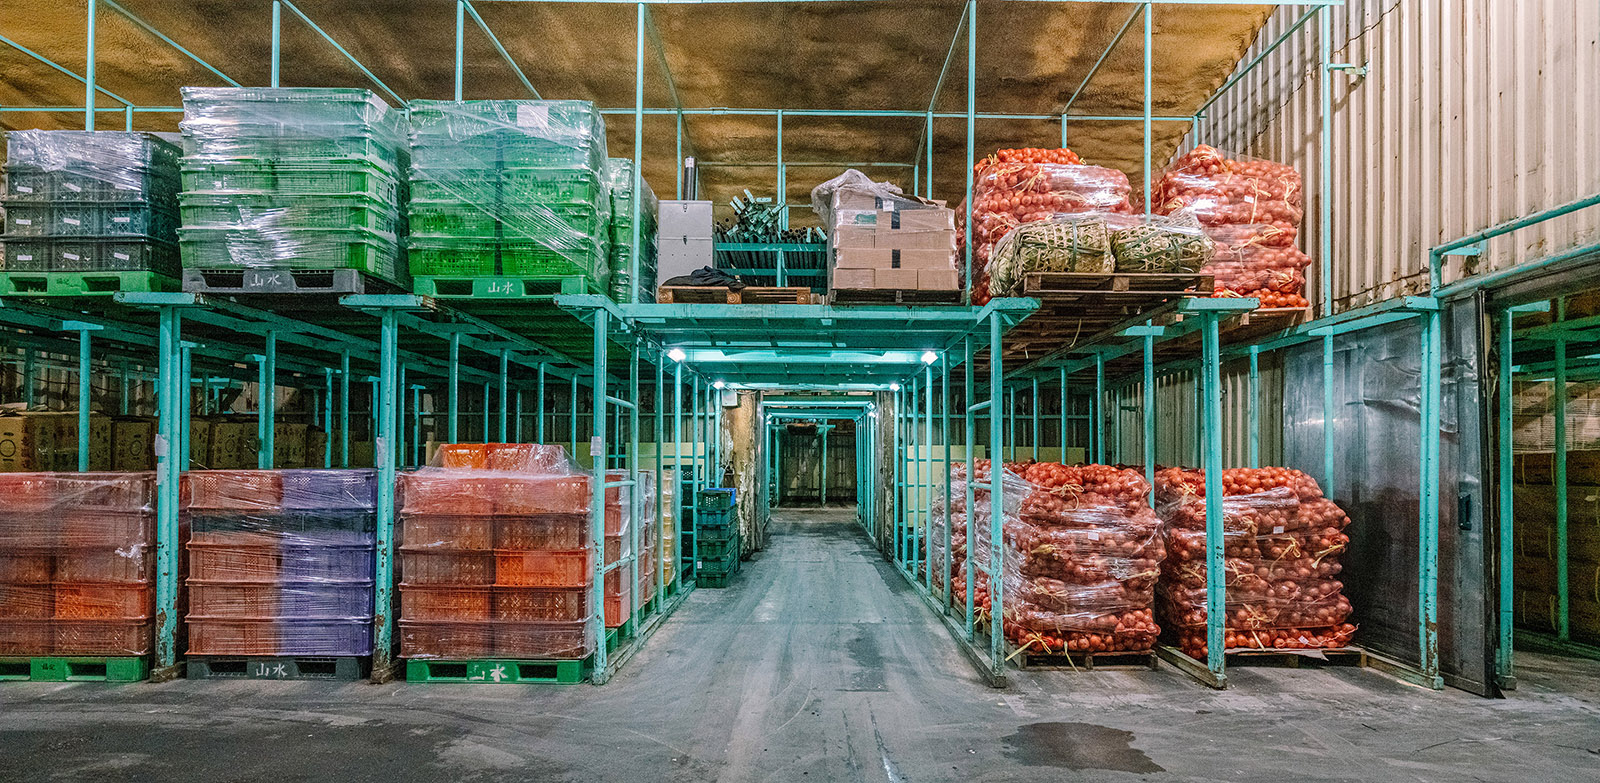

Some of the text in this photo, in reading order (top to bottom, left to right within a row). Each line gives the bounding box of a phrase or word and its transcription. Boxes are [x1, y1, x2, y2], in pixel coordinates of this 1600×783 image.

[250, 273, 282, 287] 山水
[487, 281, 514, 295] 山水
[255, 663, 288, 678] 山水
